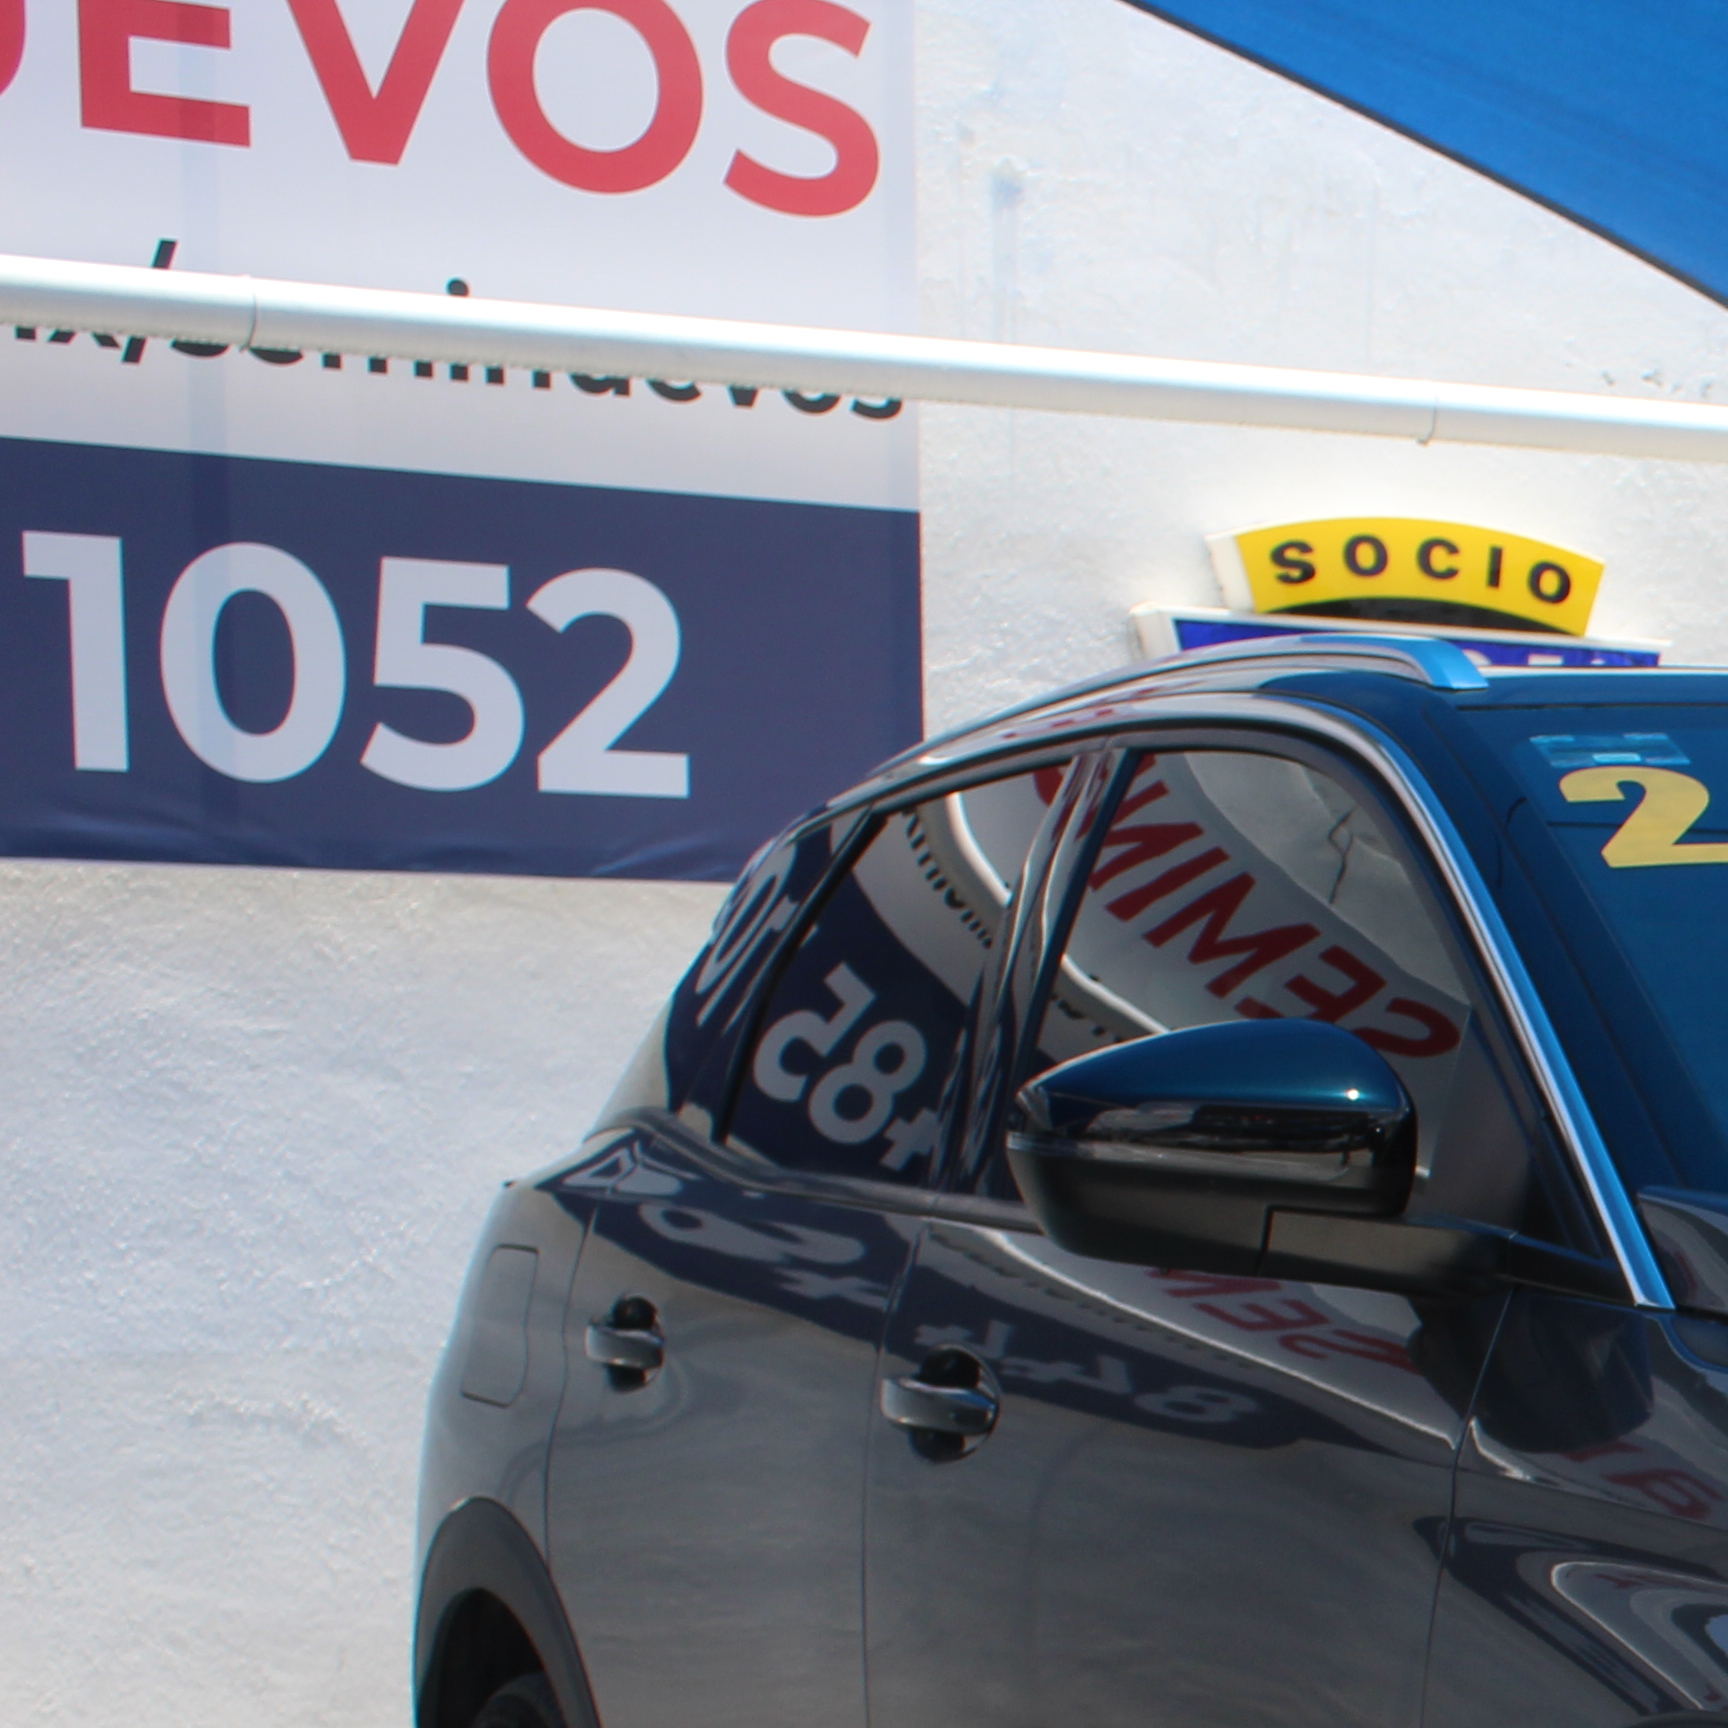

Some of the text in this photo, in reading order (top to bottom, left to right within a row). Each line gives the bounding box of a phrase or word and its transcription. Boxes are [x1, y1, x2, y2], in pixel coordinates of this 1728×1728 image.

[0, 0, 880, 218] EVOS
[22, 530, 690, 798] 1052
[1269, 533, 1572, 605] SOCIO
